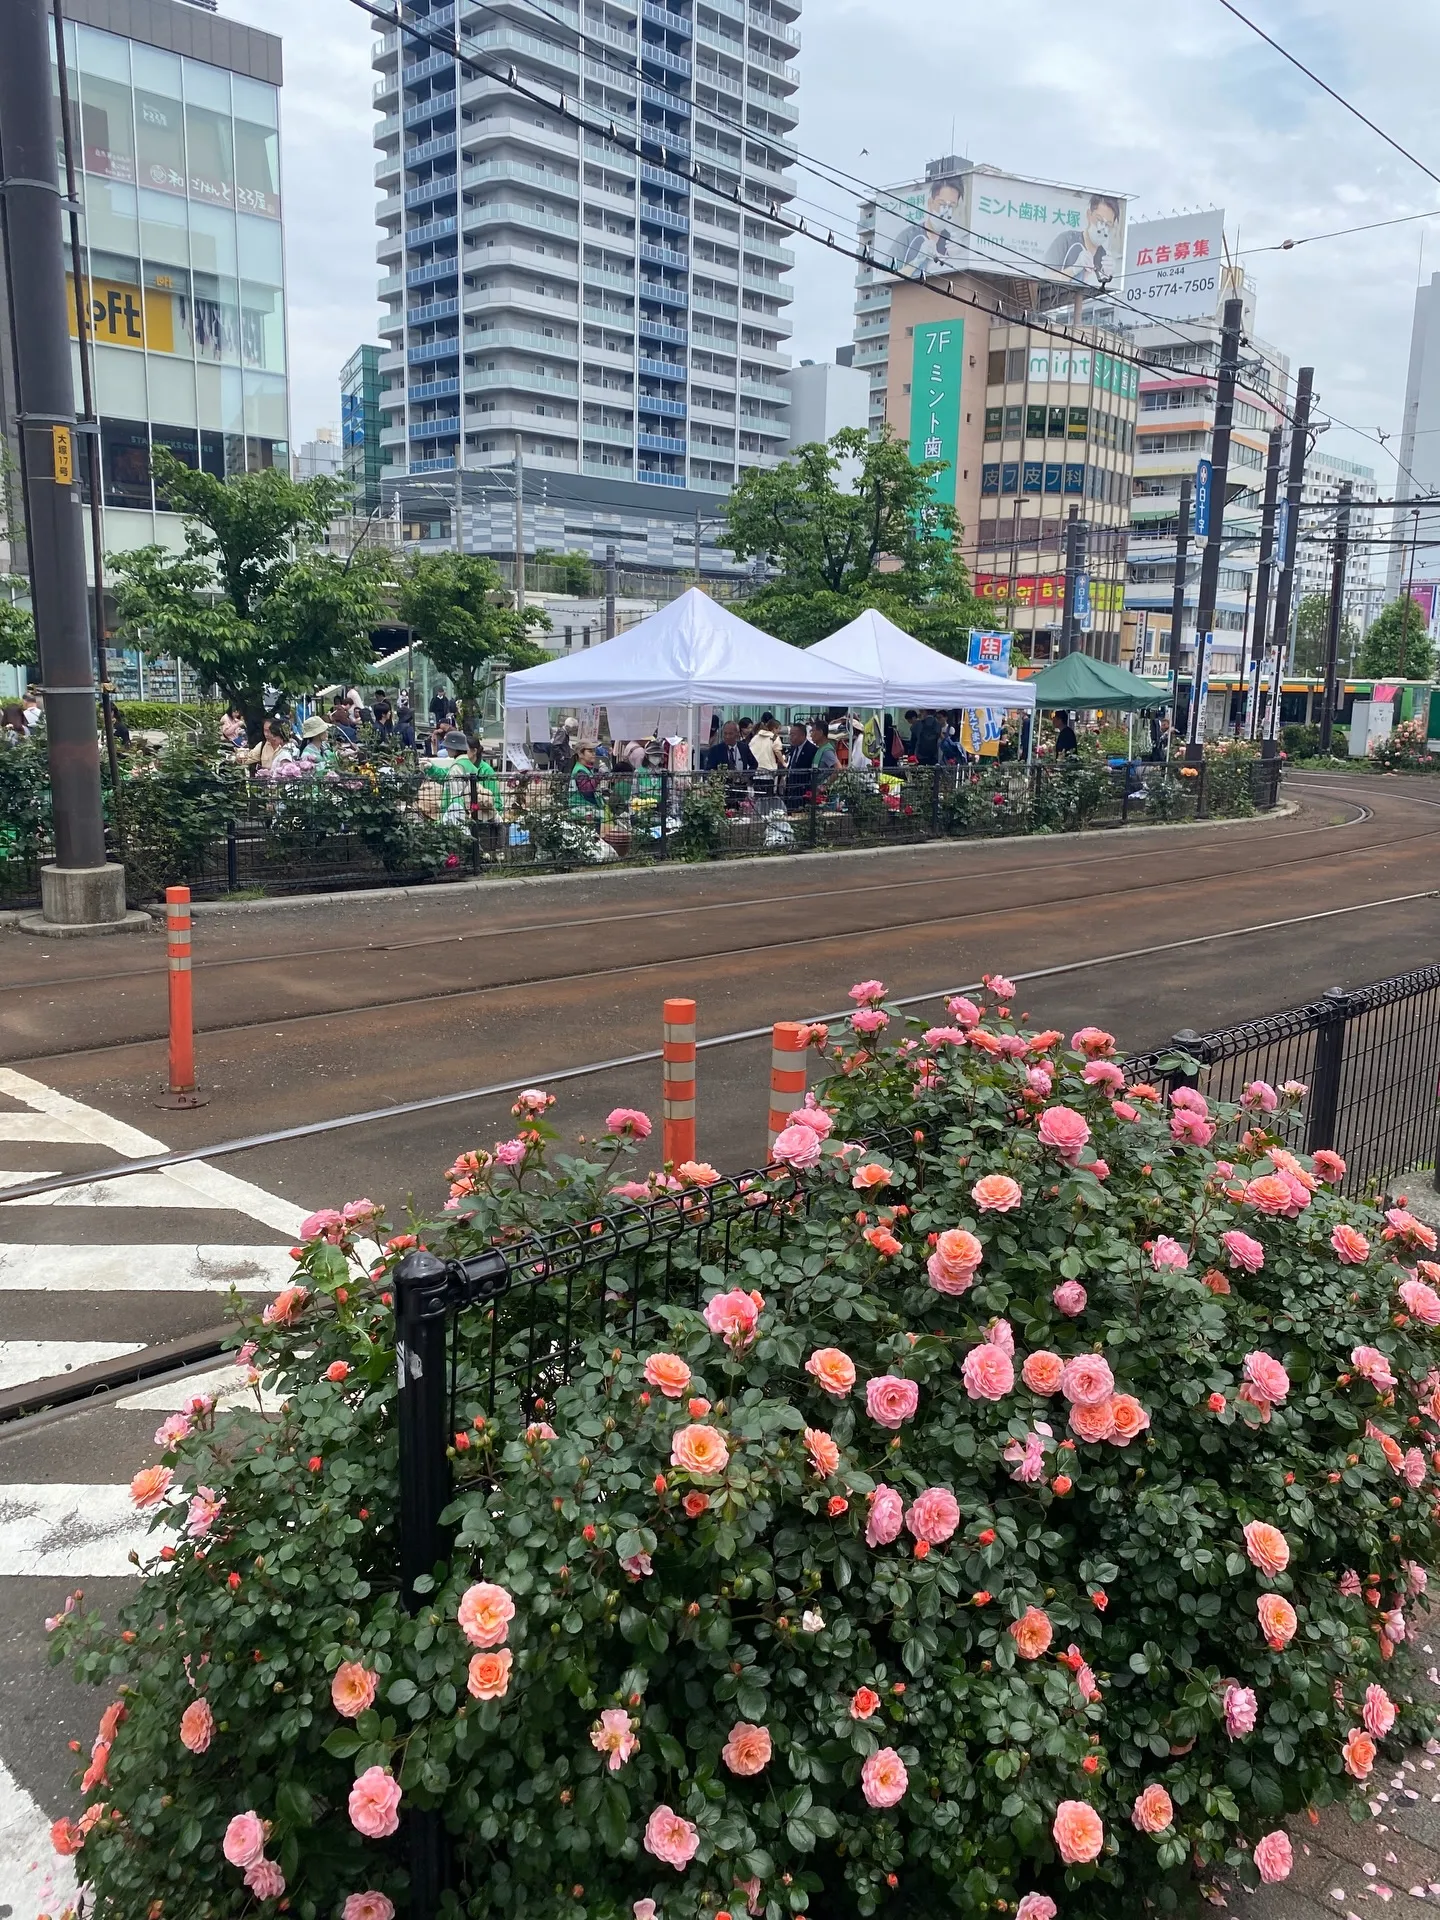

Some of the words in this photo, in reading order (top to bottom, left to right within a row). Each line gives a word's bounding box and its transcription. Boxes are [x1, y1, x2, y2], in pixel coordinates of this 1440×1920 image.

[979, 196, 1048, 223] ミント歯科
[1052, 208, 1081, 228] 大塚
[1136, 239, 1210, 267] 広告募集
[1157, 267, 1185, 279] No.244
[1127, 277, 1215, 302] 03-5774-7505
[925, 331, 951, 354] 7F
[1030, 356, 1090, 375] mint
[130, 435, 182, 450] STABUCKS
[183, 441, 213, 454] COFEE
[982, 639, 1000, 655] 生
